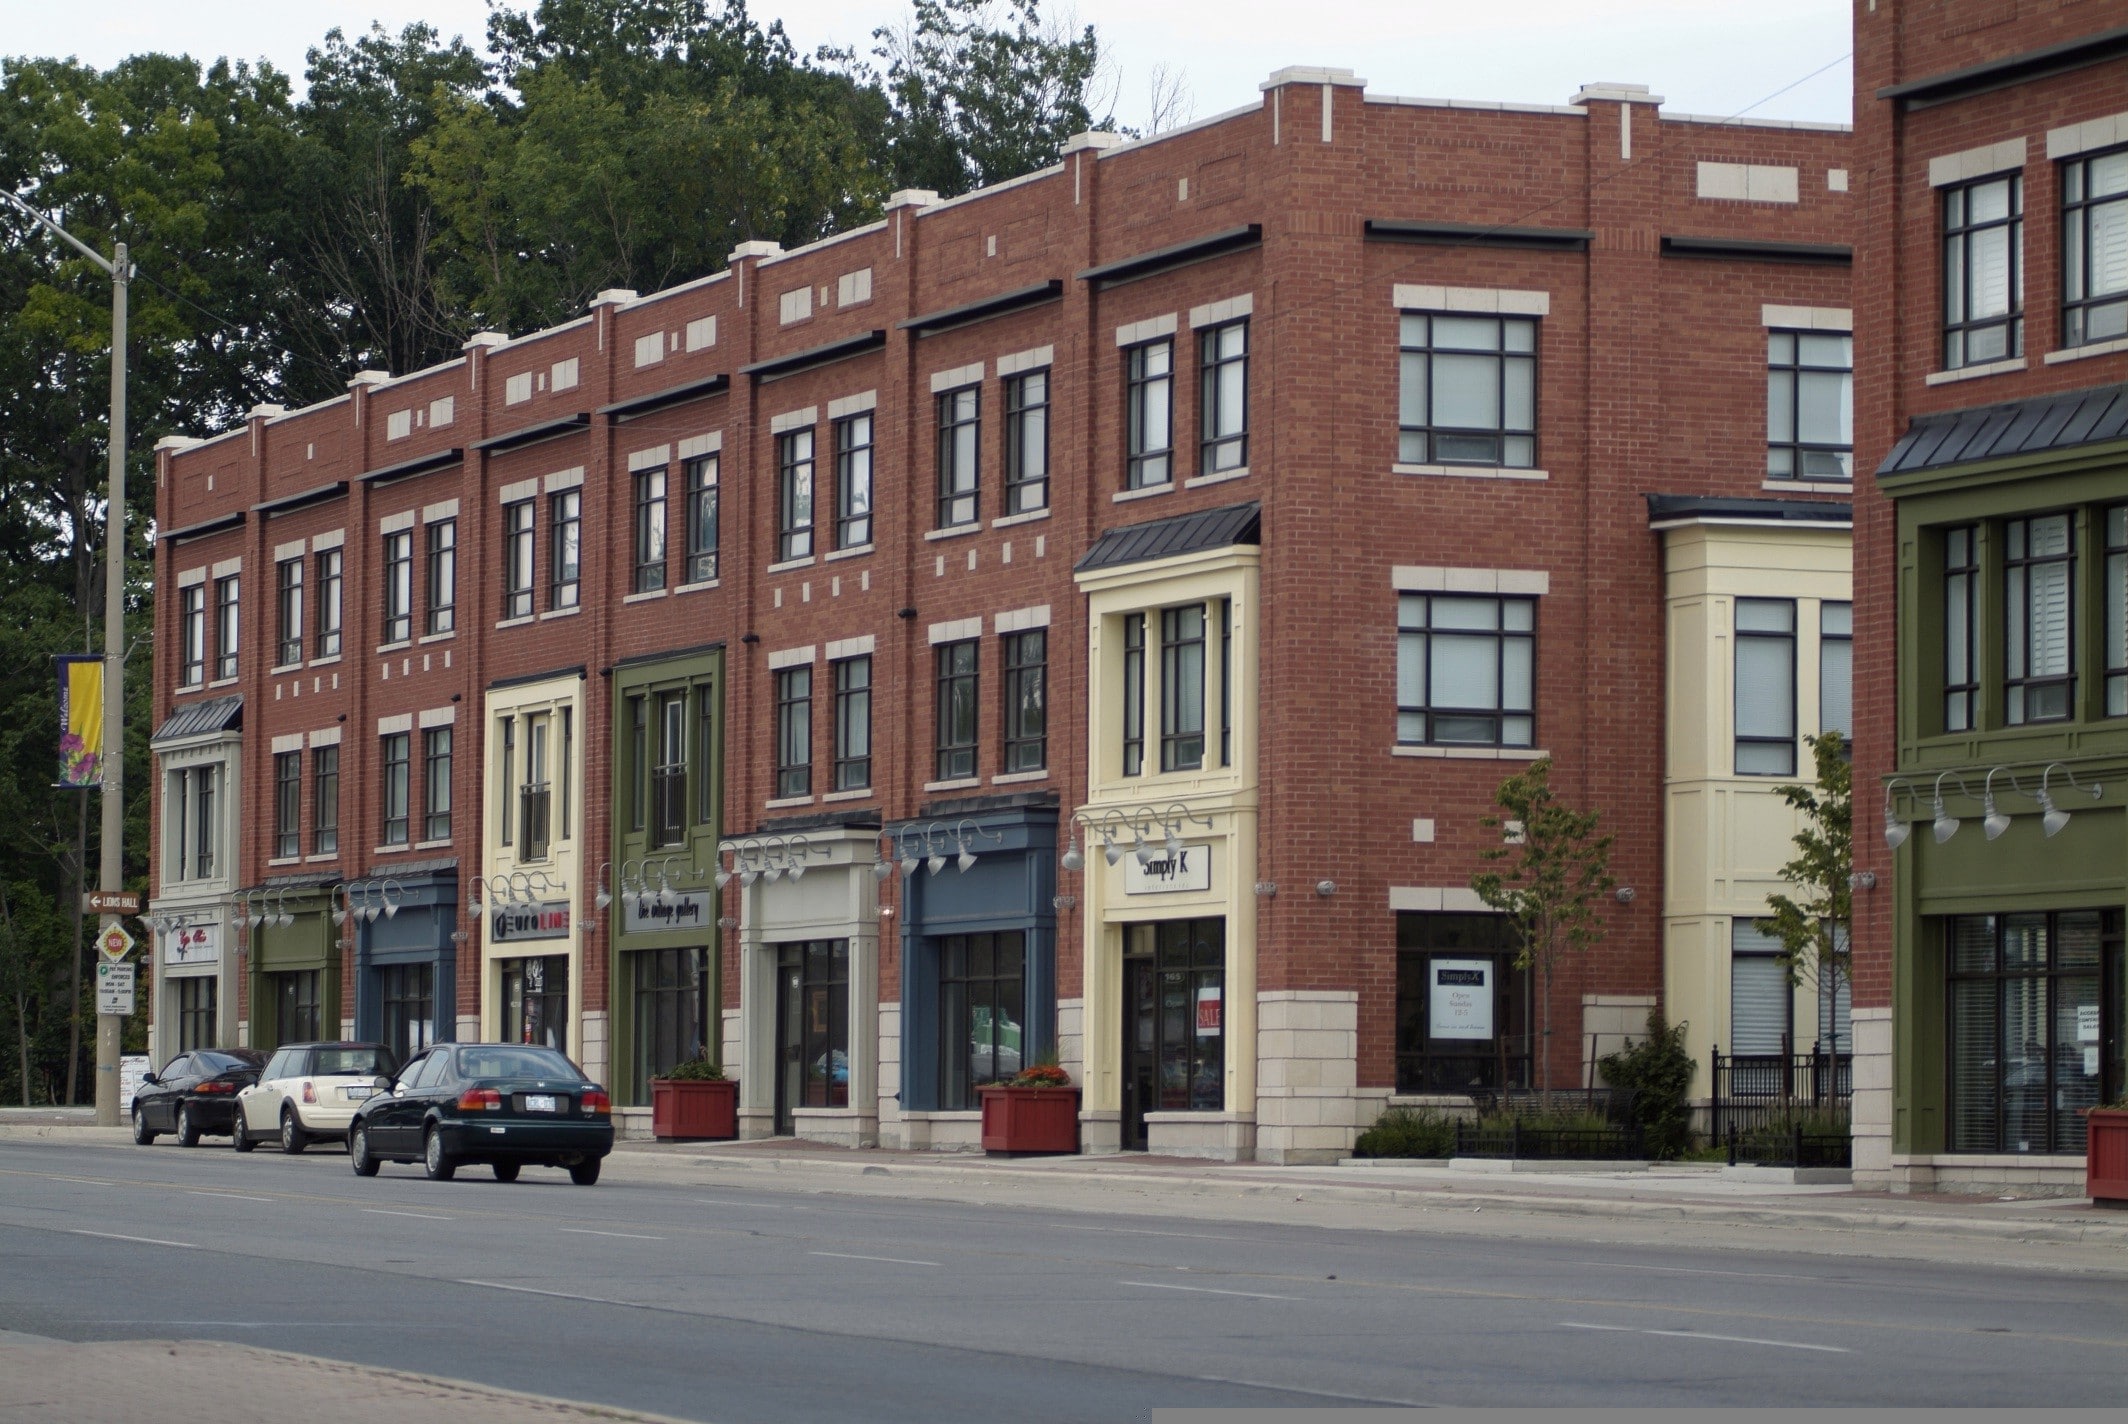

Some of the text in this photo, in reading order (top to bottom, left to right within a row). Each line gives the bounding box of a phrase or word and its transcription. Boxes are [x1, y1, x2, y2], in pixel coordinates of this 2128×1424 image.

[60, 687, 69, 731] Welcome
[1179, 851, 1189, 873] K
[103, 896, 138, 908] LIONS HALL
[676, 896, 699, 924] gallery
[108, 938, 122, 947] NEW
[1452, 992, 1470, 1001] Open
